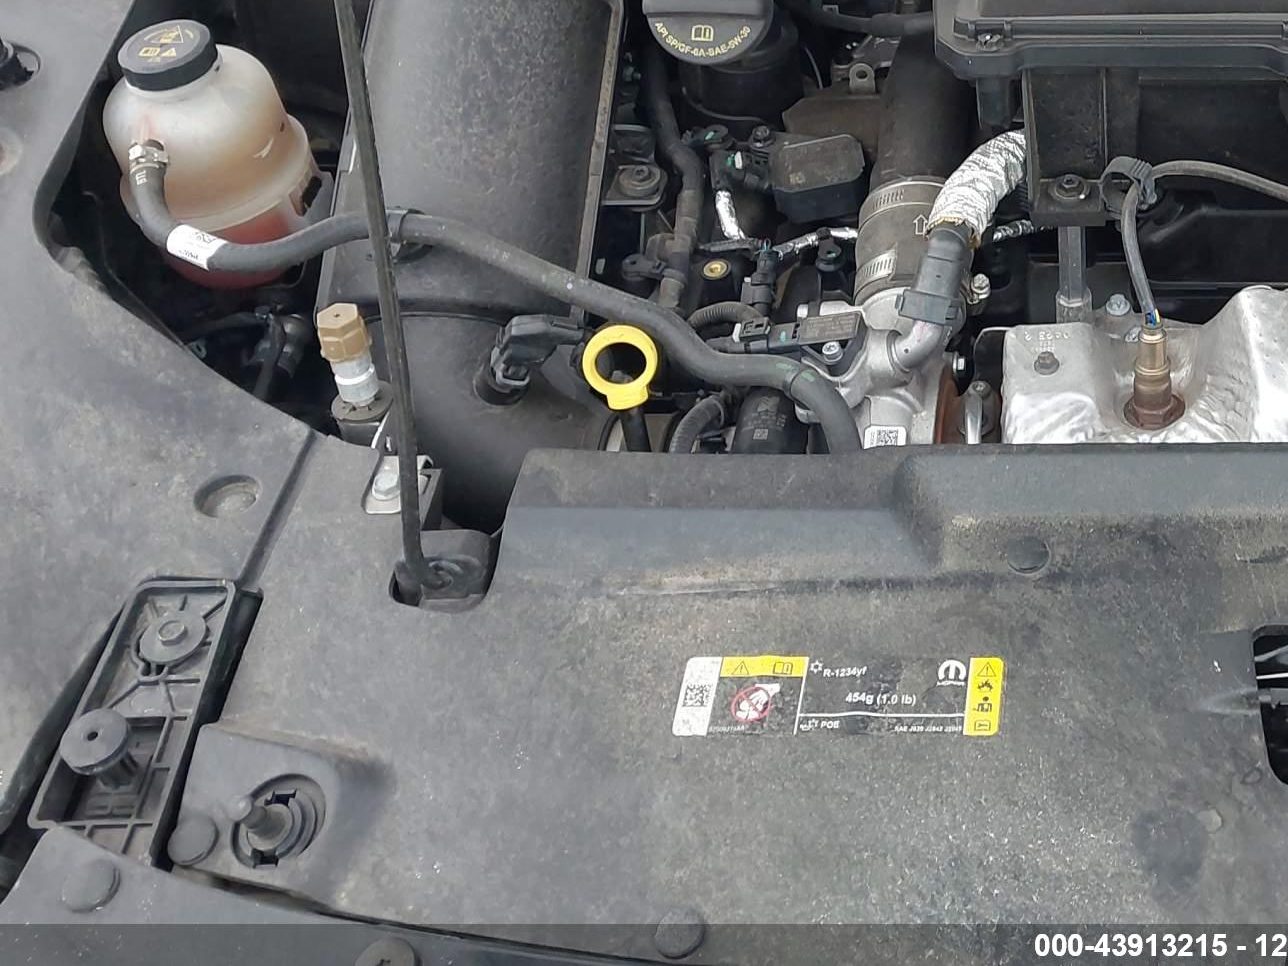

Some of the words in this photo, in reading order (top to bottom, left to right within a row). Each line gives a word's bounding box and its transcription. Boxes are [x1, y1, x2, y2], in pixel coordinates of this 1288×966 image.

[654, 21, 669, 38] API
[823, 665, 868, 678] R-1234yf
[845, 692, 874, 706] 454g
[901, 694, 917, 707] lb)
[820, 720, 841, 729] POE
